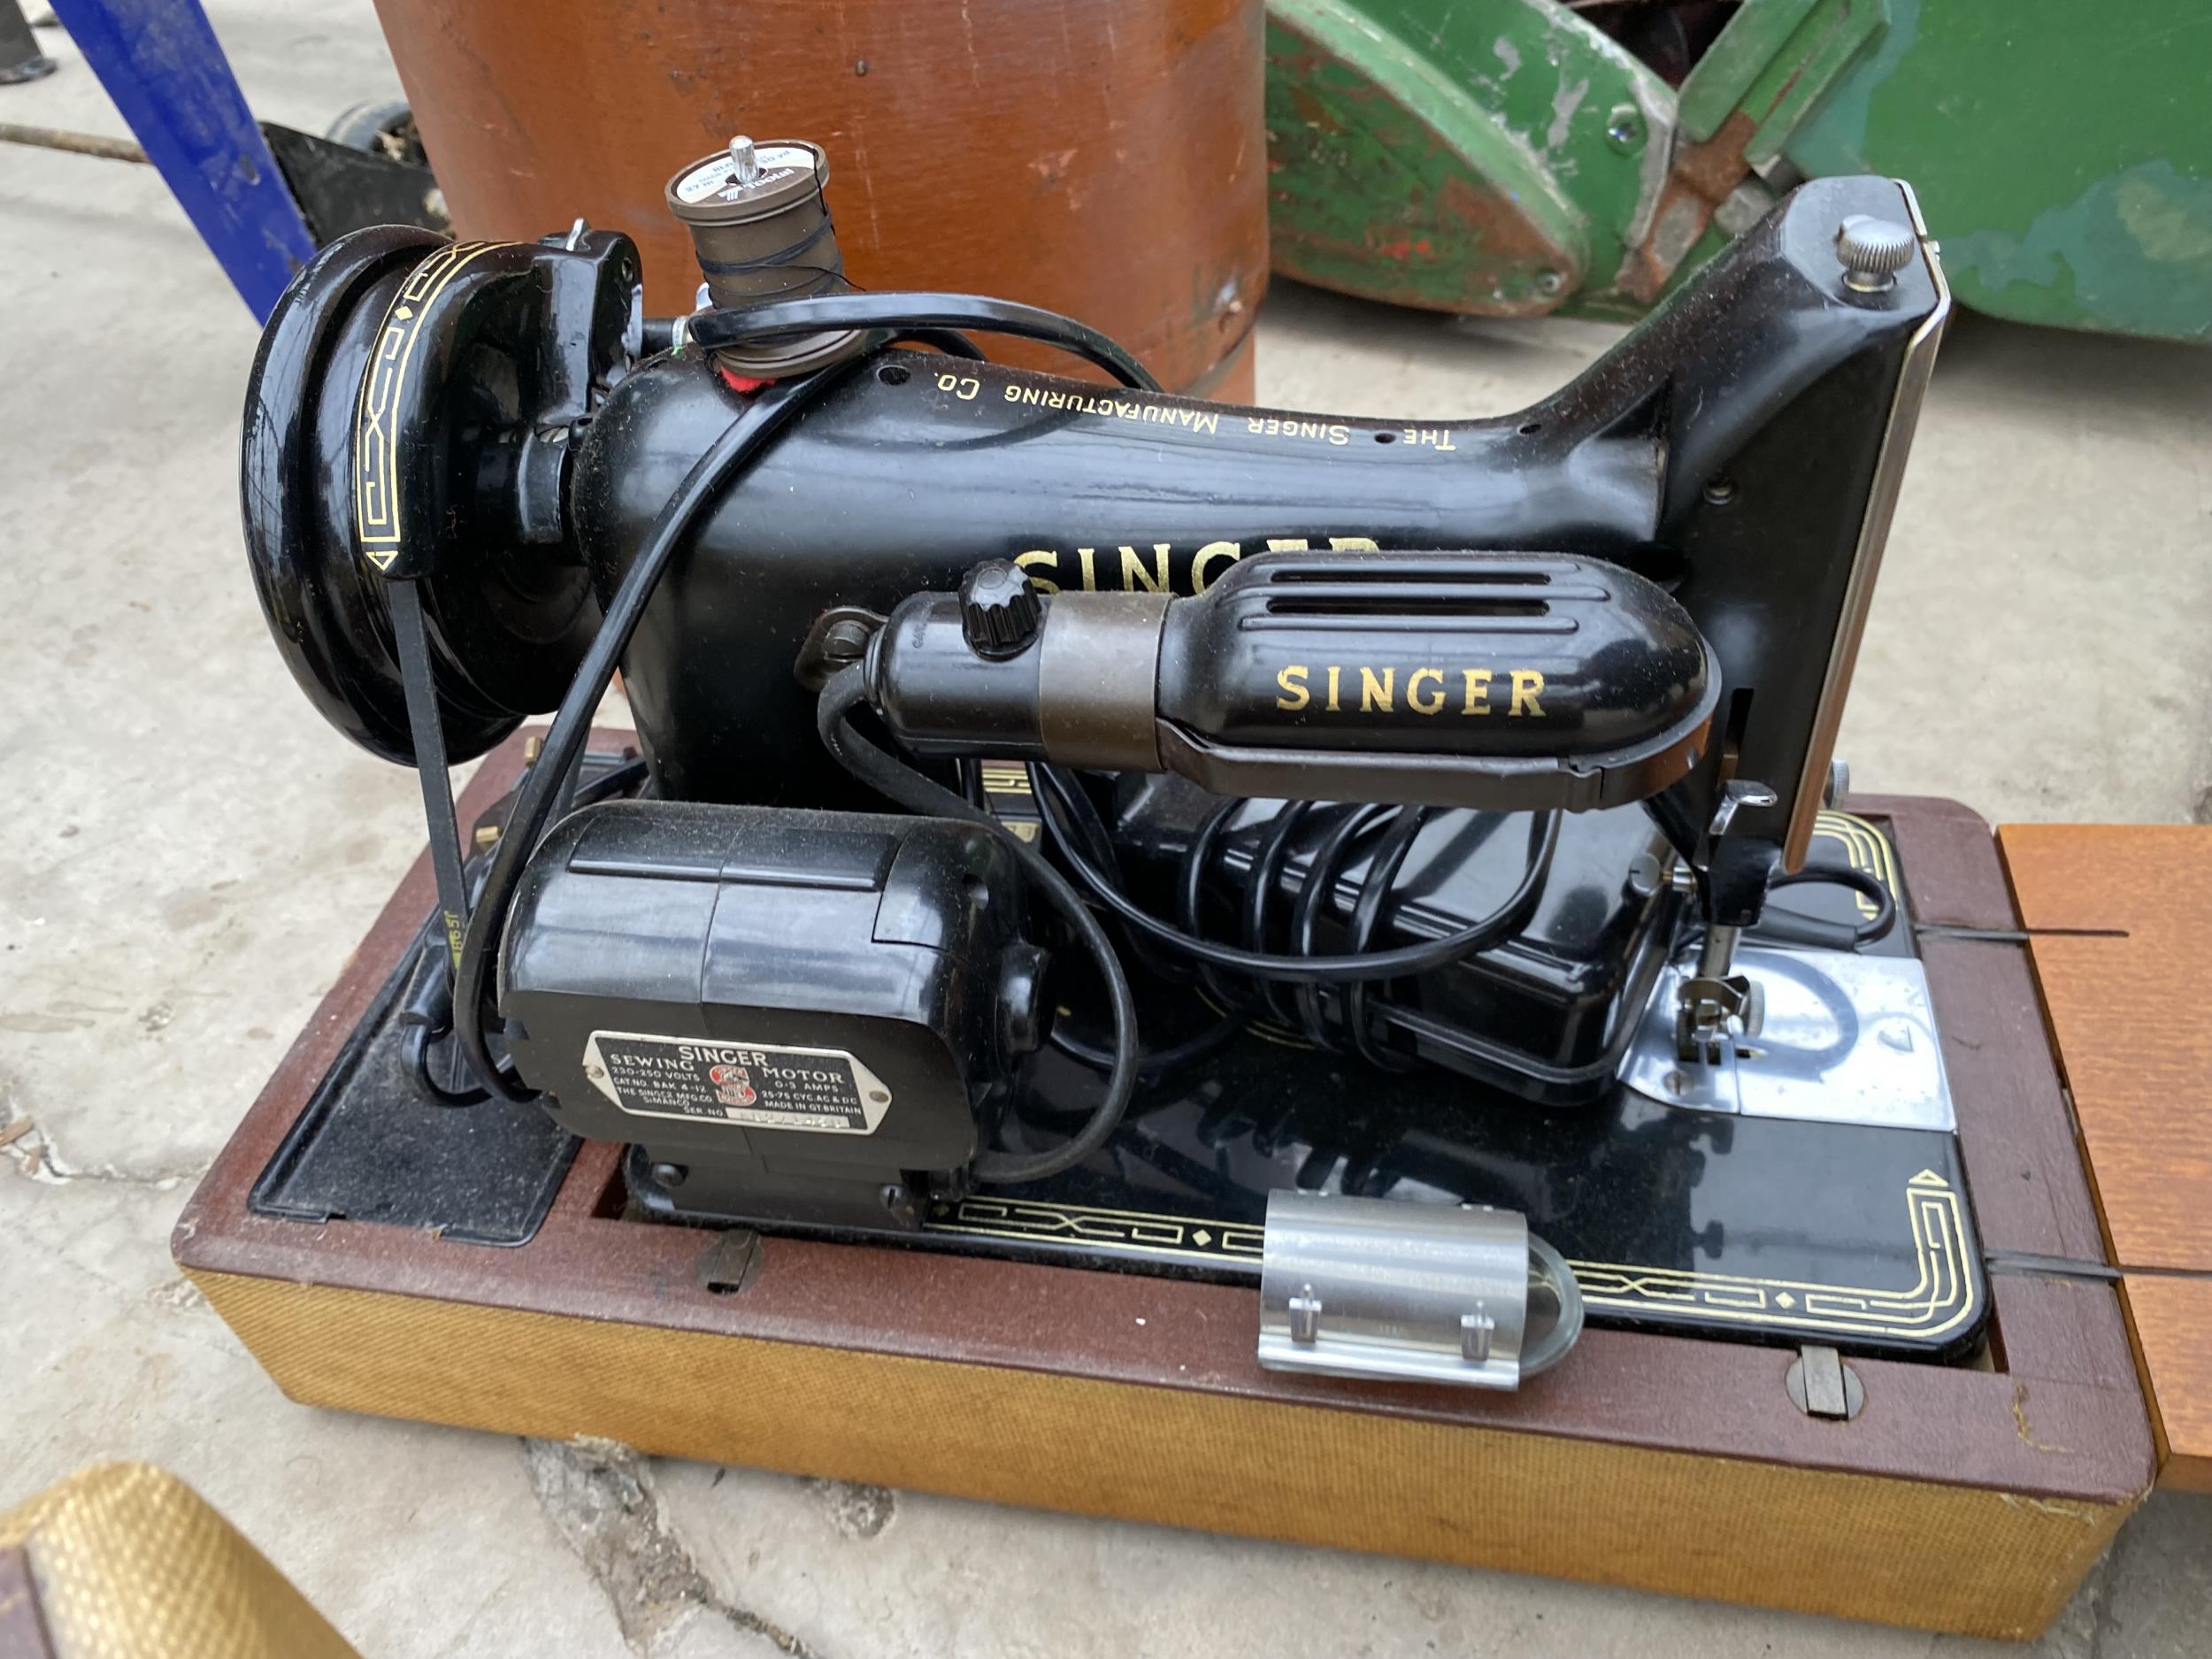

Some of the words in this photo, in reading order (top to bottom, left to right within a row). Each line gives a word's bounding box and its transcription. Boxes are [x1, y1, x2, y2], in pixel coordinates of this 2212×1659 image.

[1003, 385, 1218, 434] MANUFACTURING
[1248, 417, 1350, 446] SINGER
[1402, 428, 1456, 451] THE
[1014, 536, 1380, 595] SING
[1276, 665, 1547, 717] SINGER
[679, 1046, 769, 1067] SINGER
[611, 1054, 695, 1071] SEWING
[762, 1066, 845, 1084] MOTOR
[611, 1065, 662, 1079] 230-250
[665, 1071, 701, 1082] VOLTS
[617, 1087, 636, 1096] THE
[638, 1088, 673, 1099] SINGER
[653, 1080, 677, 1091] BAK
[804, 1082, 840, 1093] AMPS
[764, 1100, 794, 1110] MADE
[795, 1102, 807, 1111] IN
